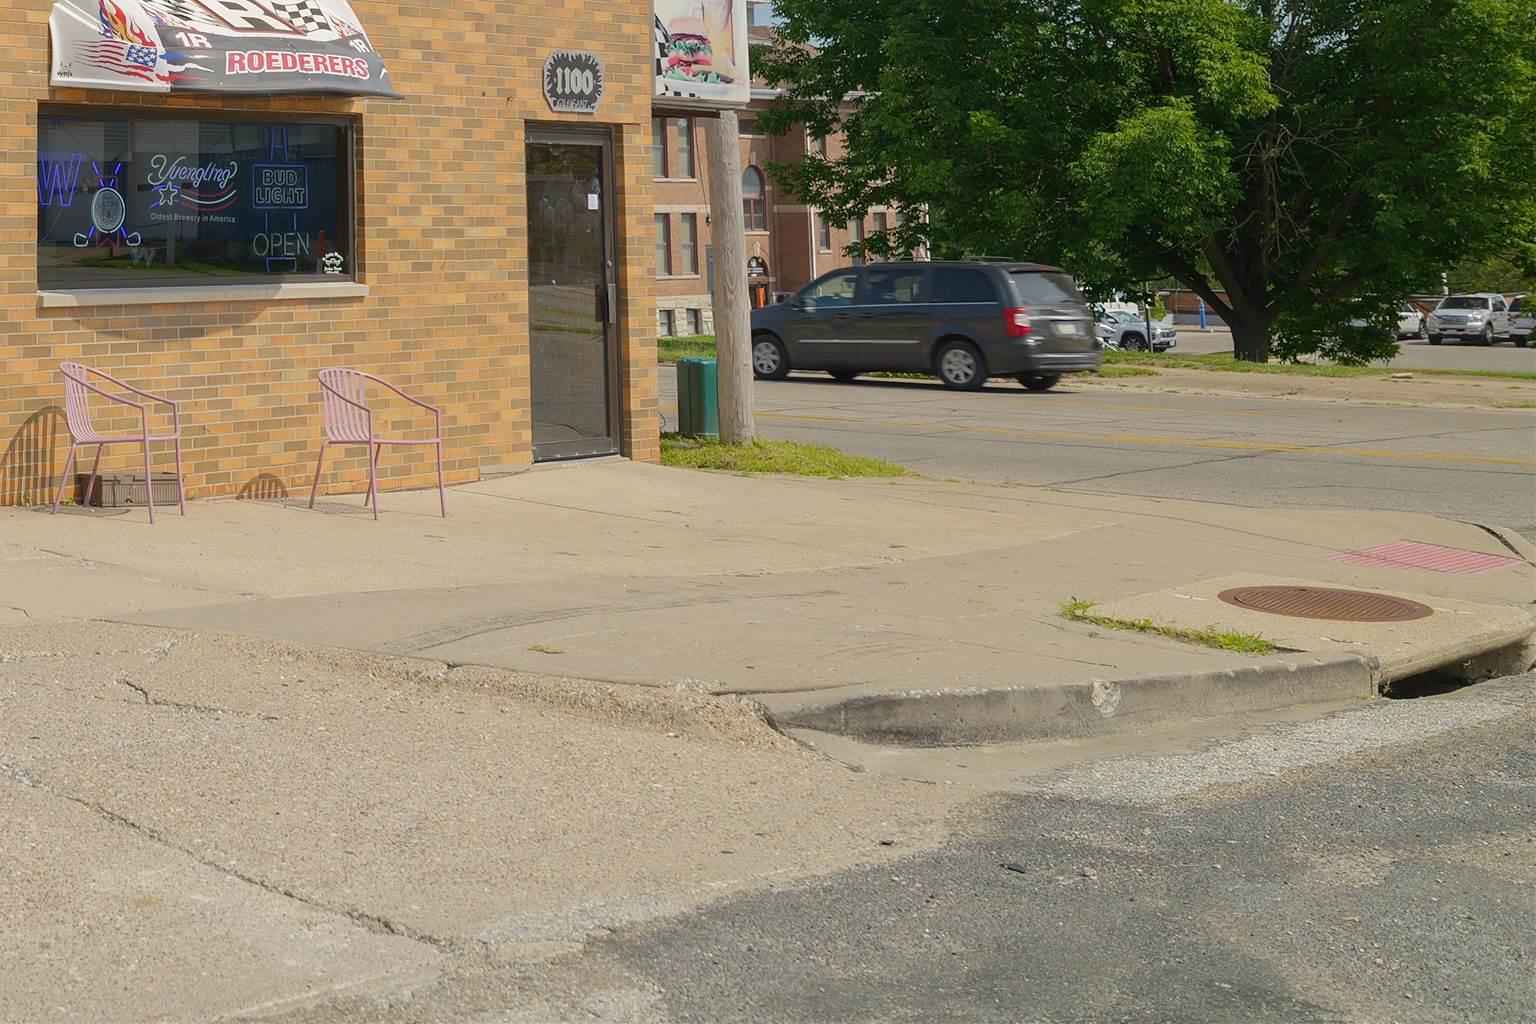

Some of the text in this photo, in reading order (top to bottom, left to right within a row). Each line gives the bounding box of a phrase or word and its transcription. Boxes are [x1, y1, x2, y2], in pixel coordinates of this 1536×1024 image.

[175, 32, 212, 49] 1R
[349, 38, 370, 53] 1R
[225, 50, 369, 80] ROEDERERS
[556, 67, 594, 96] 1100
[148, 154, 238, 189] Yuengling
[262, 169, 297, 186] BUD
[255, 188, 305, 204] LIGHT
[150, 212, 236, 223] Oldest Brewery in America
[253, 232, 310, 256] OPEN
